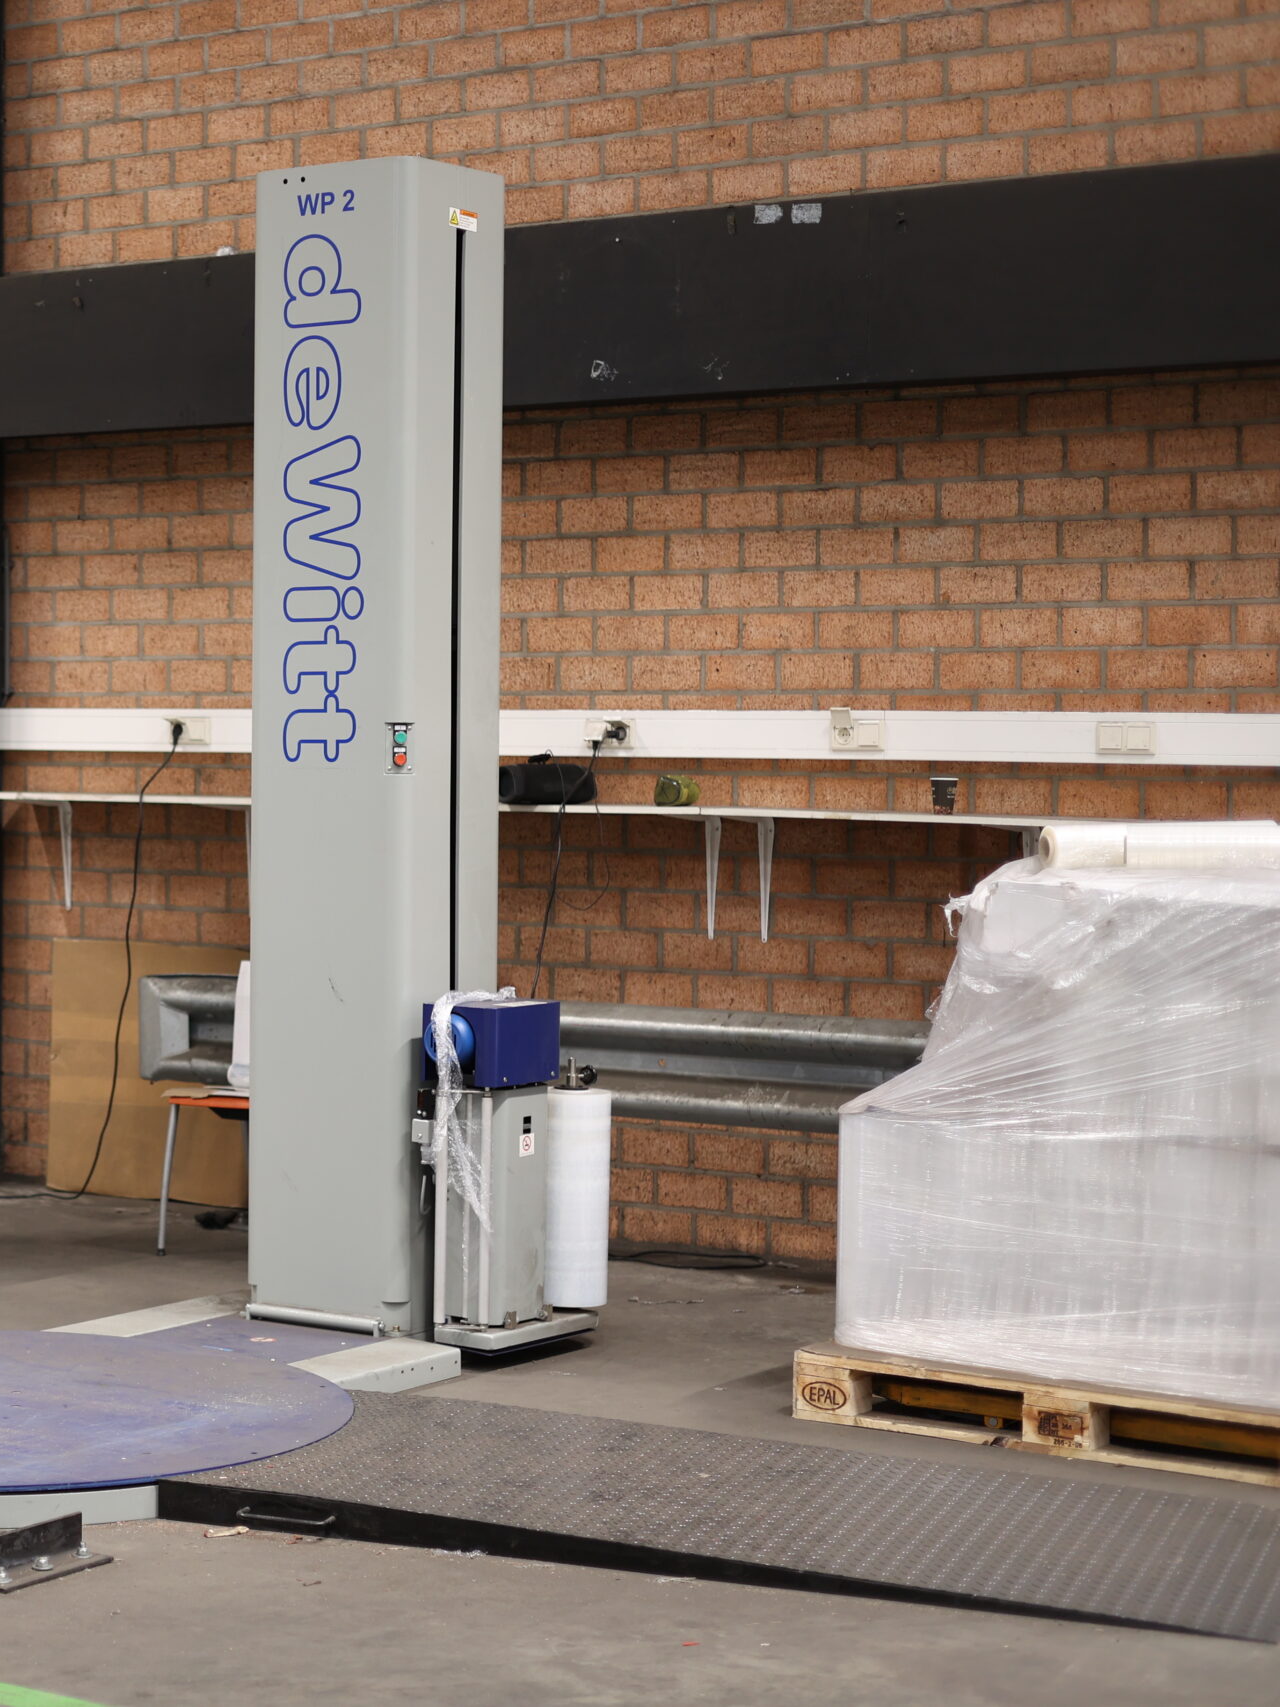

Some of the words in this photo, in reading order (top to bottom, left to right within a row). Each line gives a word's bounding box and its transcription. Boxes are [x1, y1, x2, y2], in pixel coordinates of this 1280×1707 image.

[297, 192, 336, 216] WP
[341, 190, 356, 212] 2
[809, 1386, 840, 1406] EPAL
